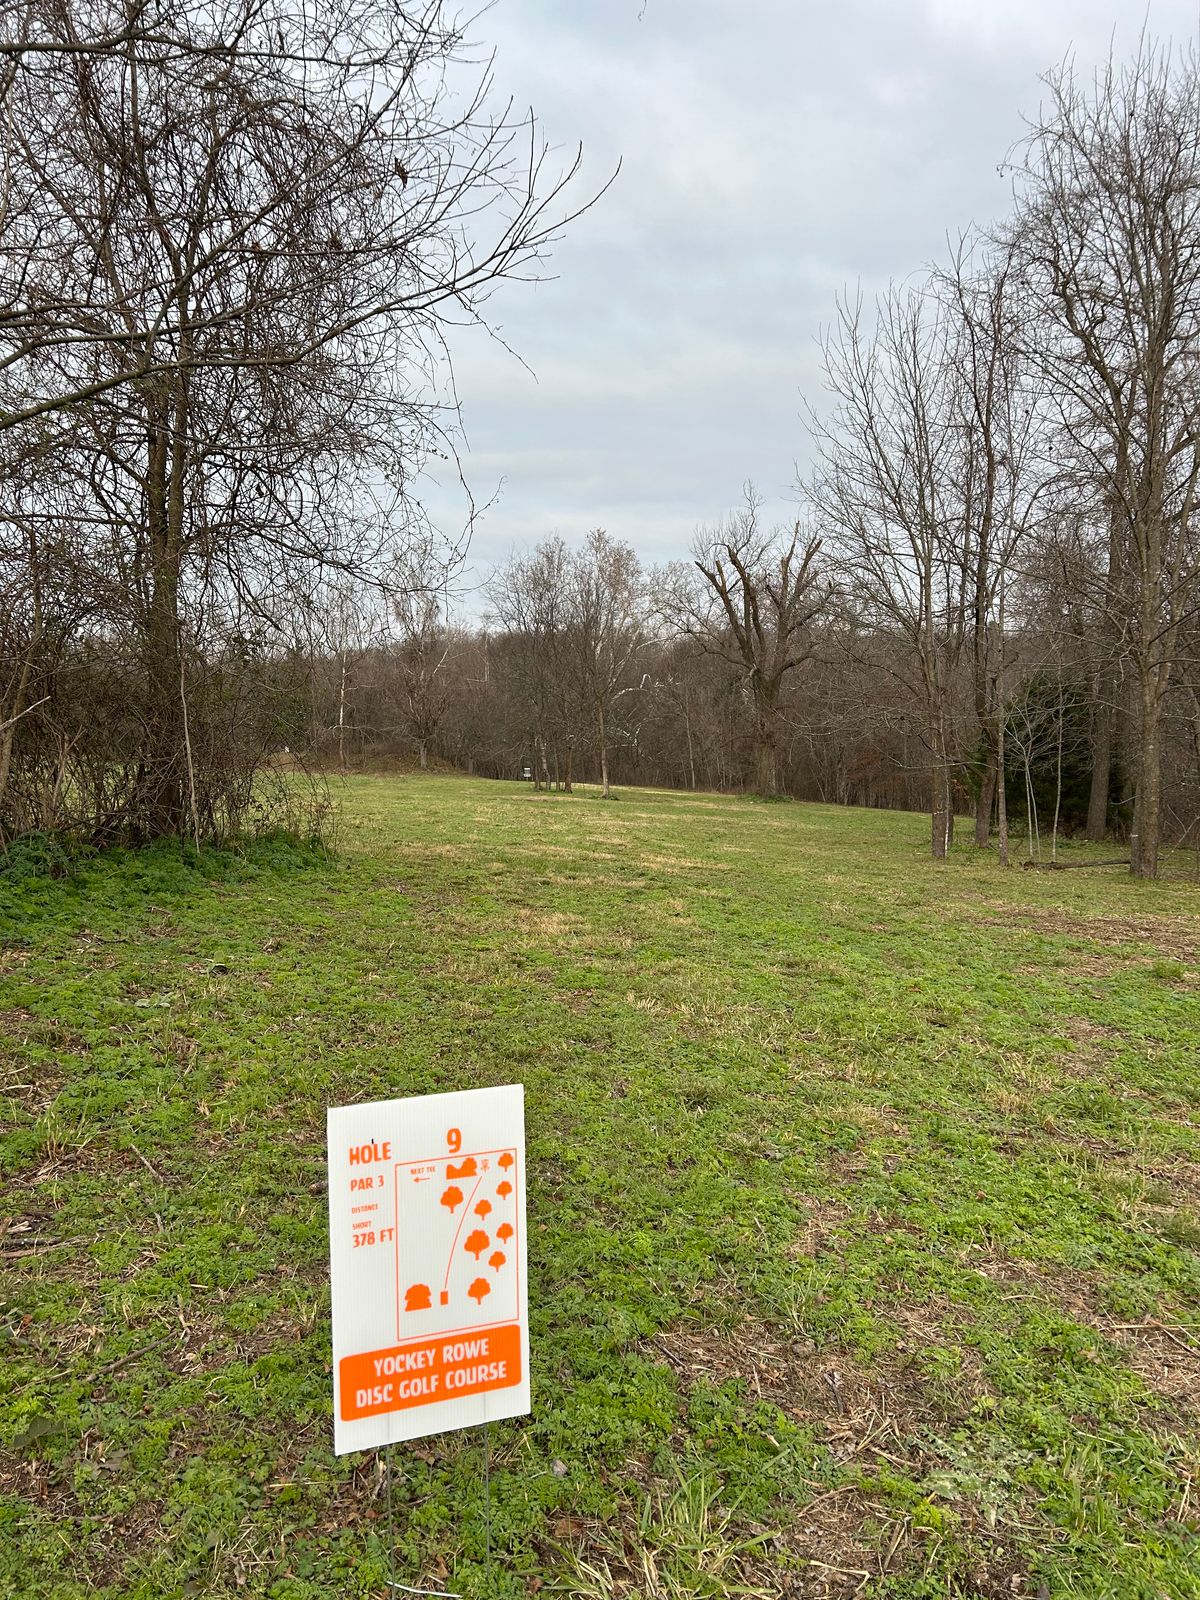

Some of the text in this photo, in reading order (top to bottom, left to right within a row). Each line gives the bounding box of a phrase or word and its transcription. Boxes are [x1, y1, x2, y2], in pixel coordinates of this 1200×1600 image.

[349, 1128, 461, 1166] HOLE 9
[410, 1167, 425, 1175] NEXT
[350, 1175, 385, 1192] PAR 3
[351, 1203, 379, 1214] DISTANCE
[352, 1221, 372, 1230] SHORT
[352, 1228, 394, 1248] 378 FT
[373, 1338, 490, 1377] YOCKEY ROWE
[356, 1361, 507, 1408] DISC GOLF COURSE
